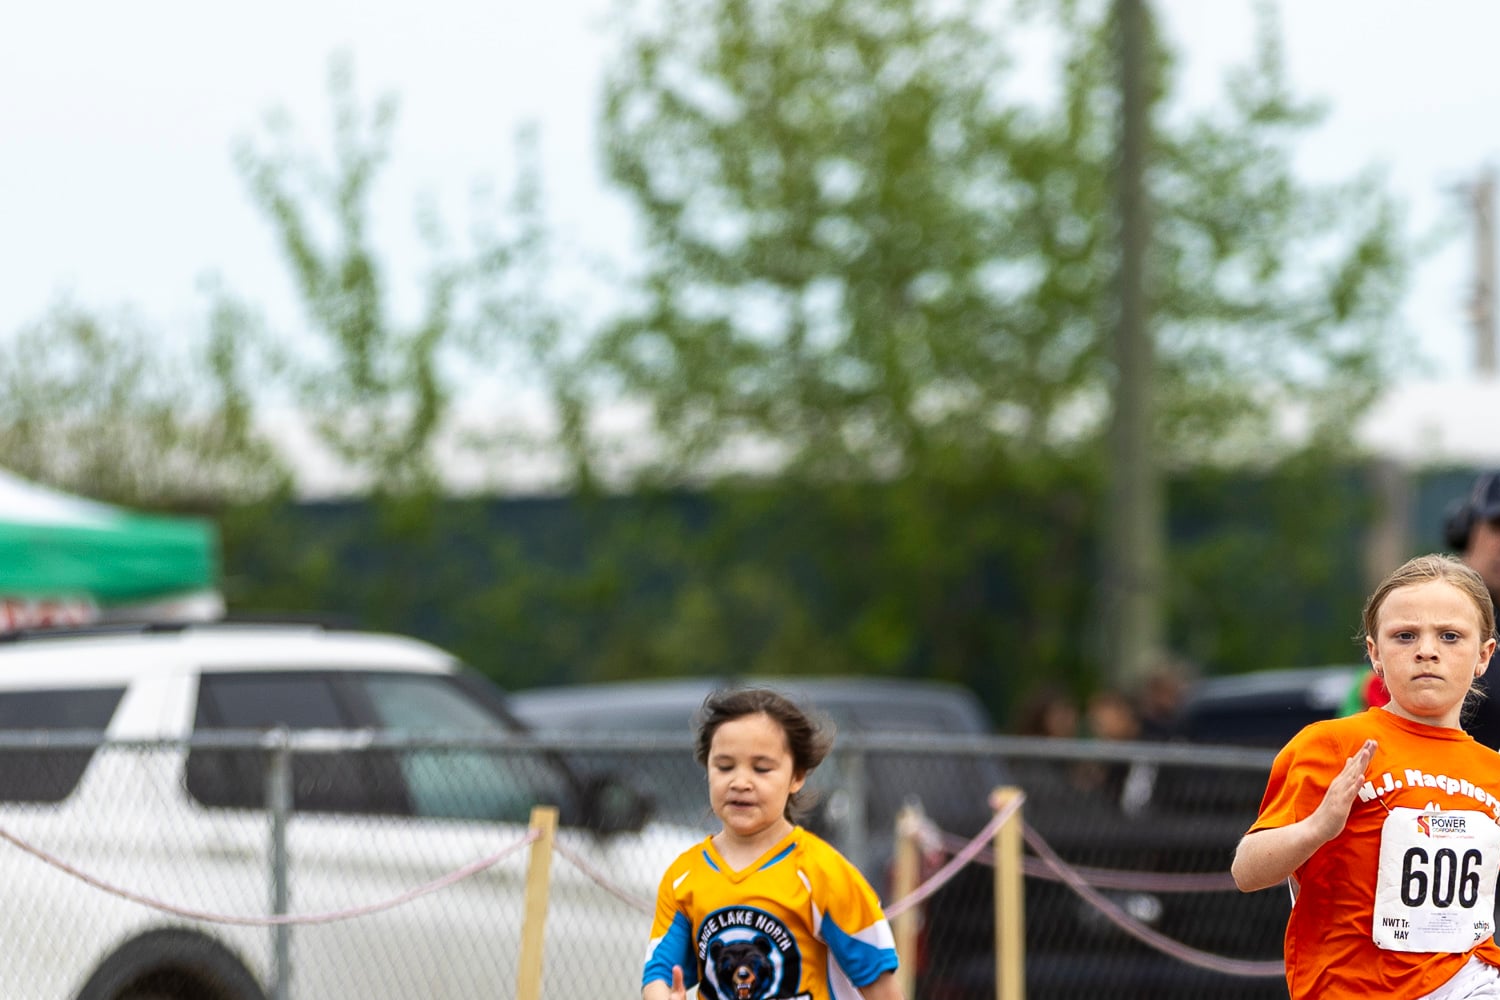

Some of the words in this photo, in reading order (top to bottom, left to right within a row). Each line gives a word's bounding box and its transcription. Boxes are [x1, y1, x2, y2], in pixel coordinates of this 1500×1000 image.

[1431, 818, 1466, 828] POWER
[1401, 847, 1482, 908] 606
[1382, 917, 1400, 928] NWT
[718, 910, 754, 928] LAKE
[755, 914, 793, 952] NORTH
[1394, 930, 1409, 940] HAY
